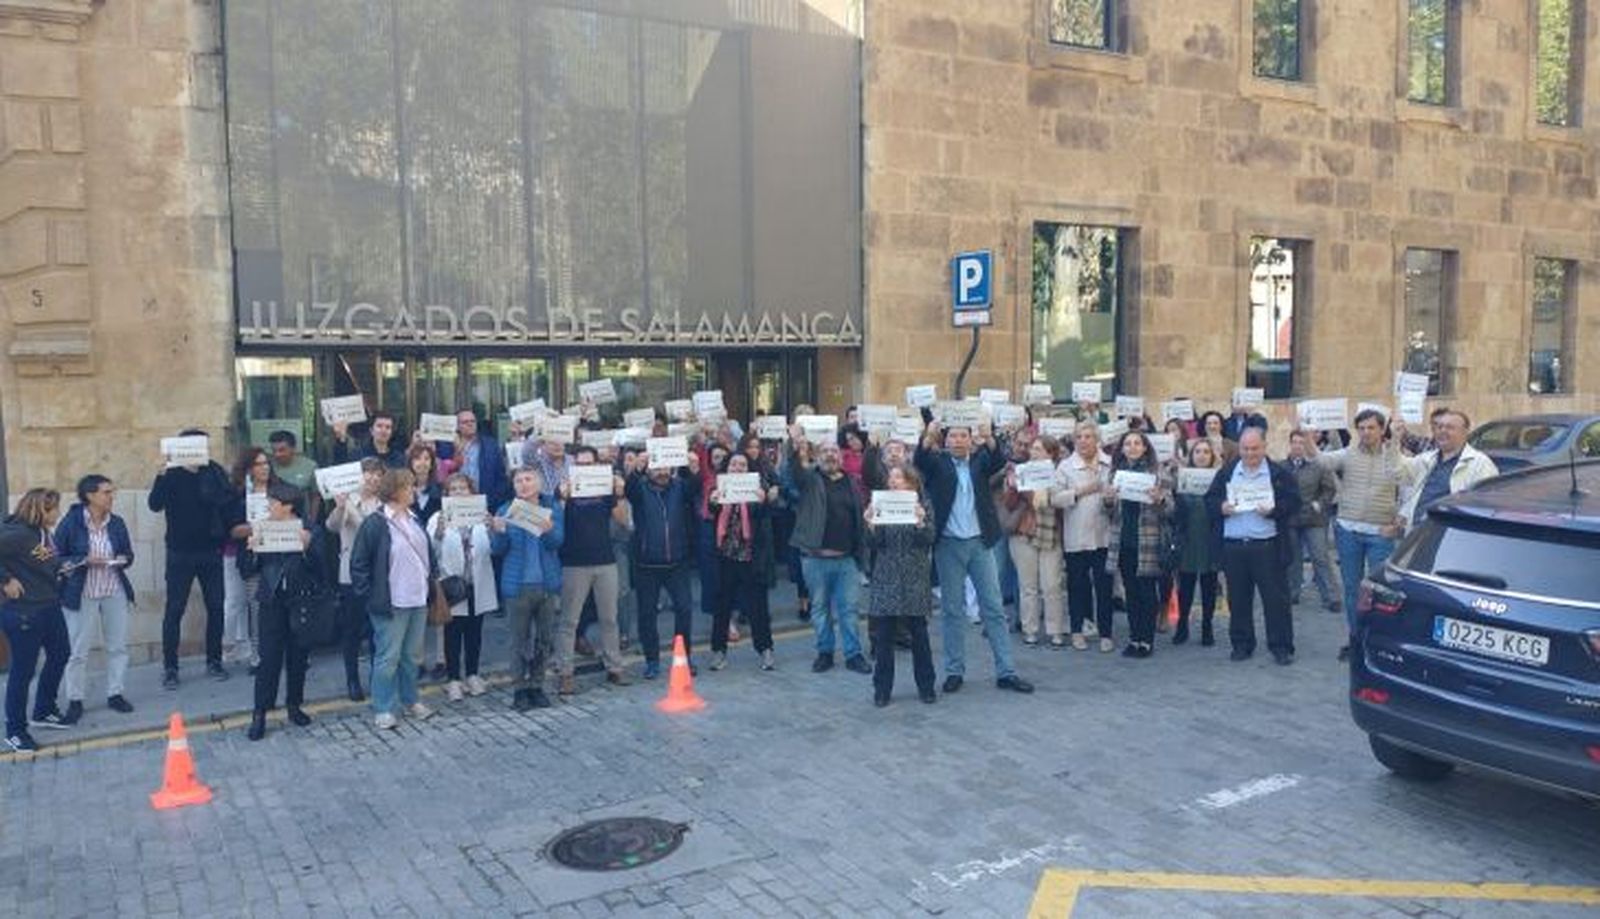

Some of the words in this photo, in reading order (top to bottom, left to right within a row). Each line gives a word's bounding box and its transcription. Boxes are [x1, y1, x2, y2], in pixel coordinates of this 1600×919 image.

[960, 258, 983, 303] P
[252, 300, 528, 339] JUZGADOS
[548, 306, 604, 342] DE
[620, 308, 858, 344] SALAMANCA
[1471, 597, 1507, 614] Jeep
[1449, 621, 1496, 649] 0225
[1502, 633, 1543, 658] KCG
